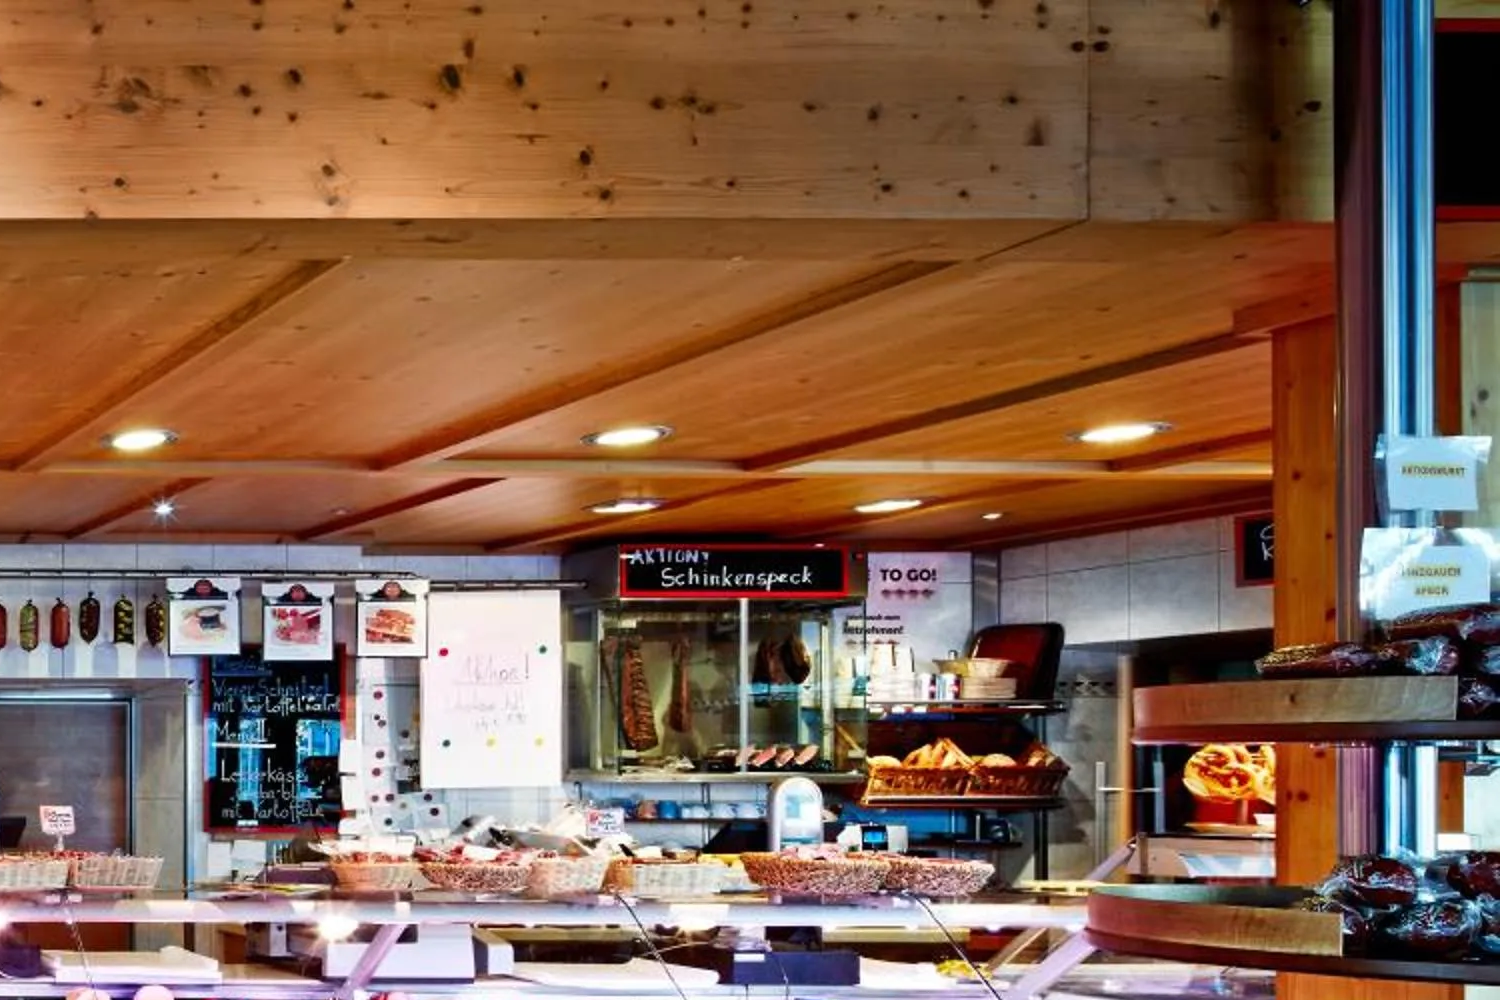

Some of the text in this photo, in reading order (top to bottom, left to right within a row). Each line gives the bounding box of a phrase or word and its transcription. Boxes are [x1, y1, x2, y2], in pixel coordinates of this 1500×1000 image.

[660, 565, 813, 592] Schinkenspeck
[880, 568, 937, 582] TO GO!
